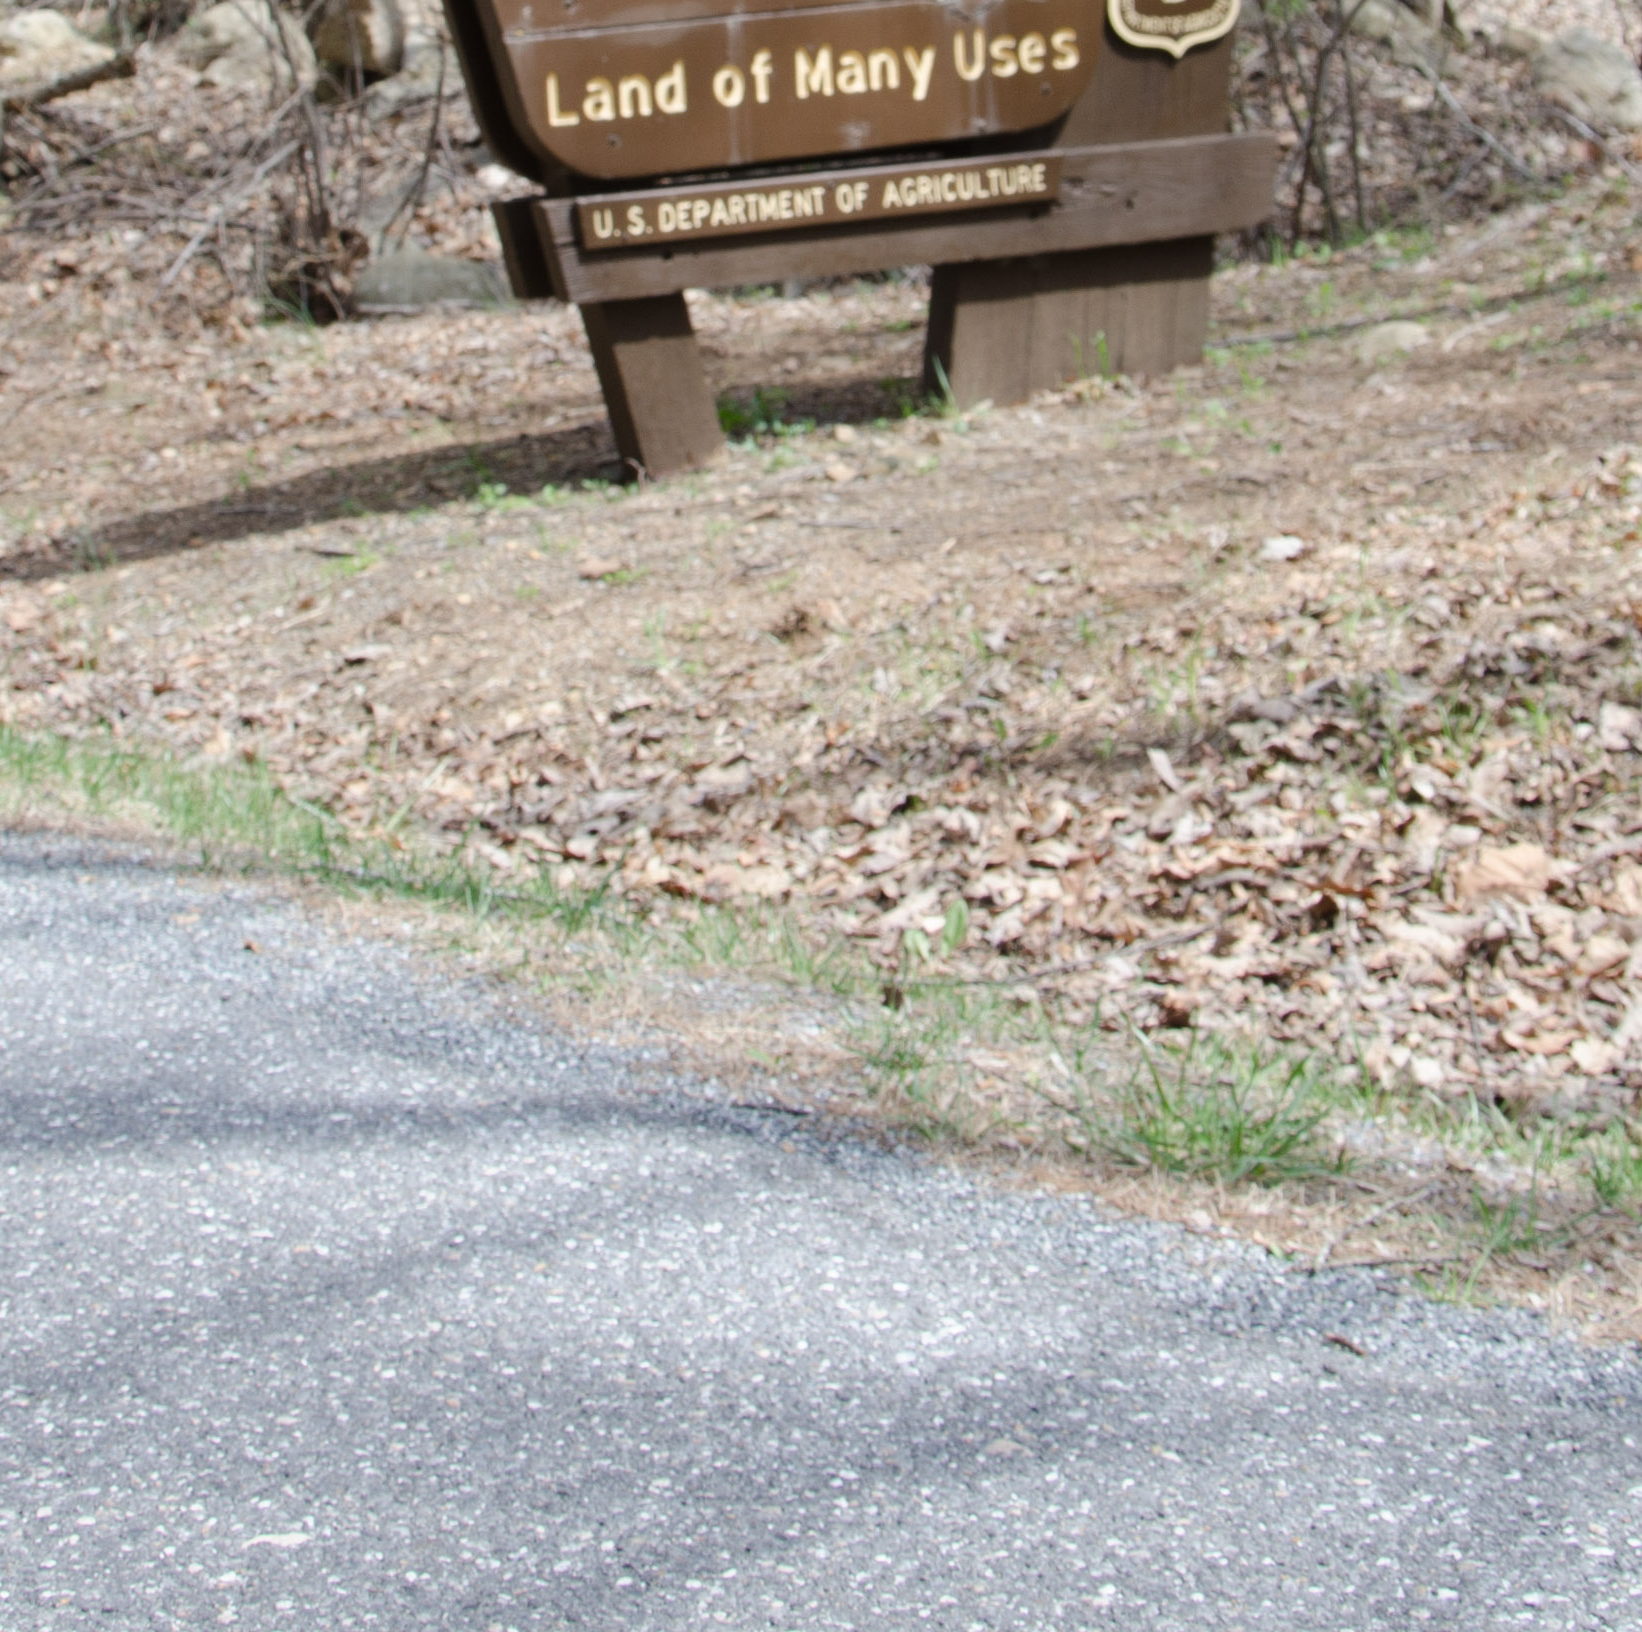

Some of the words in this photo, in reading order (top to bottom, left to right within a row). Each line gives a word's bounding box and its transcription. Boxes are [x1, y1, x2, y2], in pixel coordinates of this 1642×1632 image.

[545, 58, 687, 128] Land
[713, 47, 773, 108] of
[794, 43, 936, 102] Many
[953, 27, 1081, 82] Uses
[658, 185, 826, 234] DEPARTMENT
[835, 181, 869, 215] OF
[881, 163, 1048, 209] AGRICULTURE
